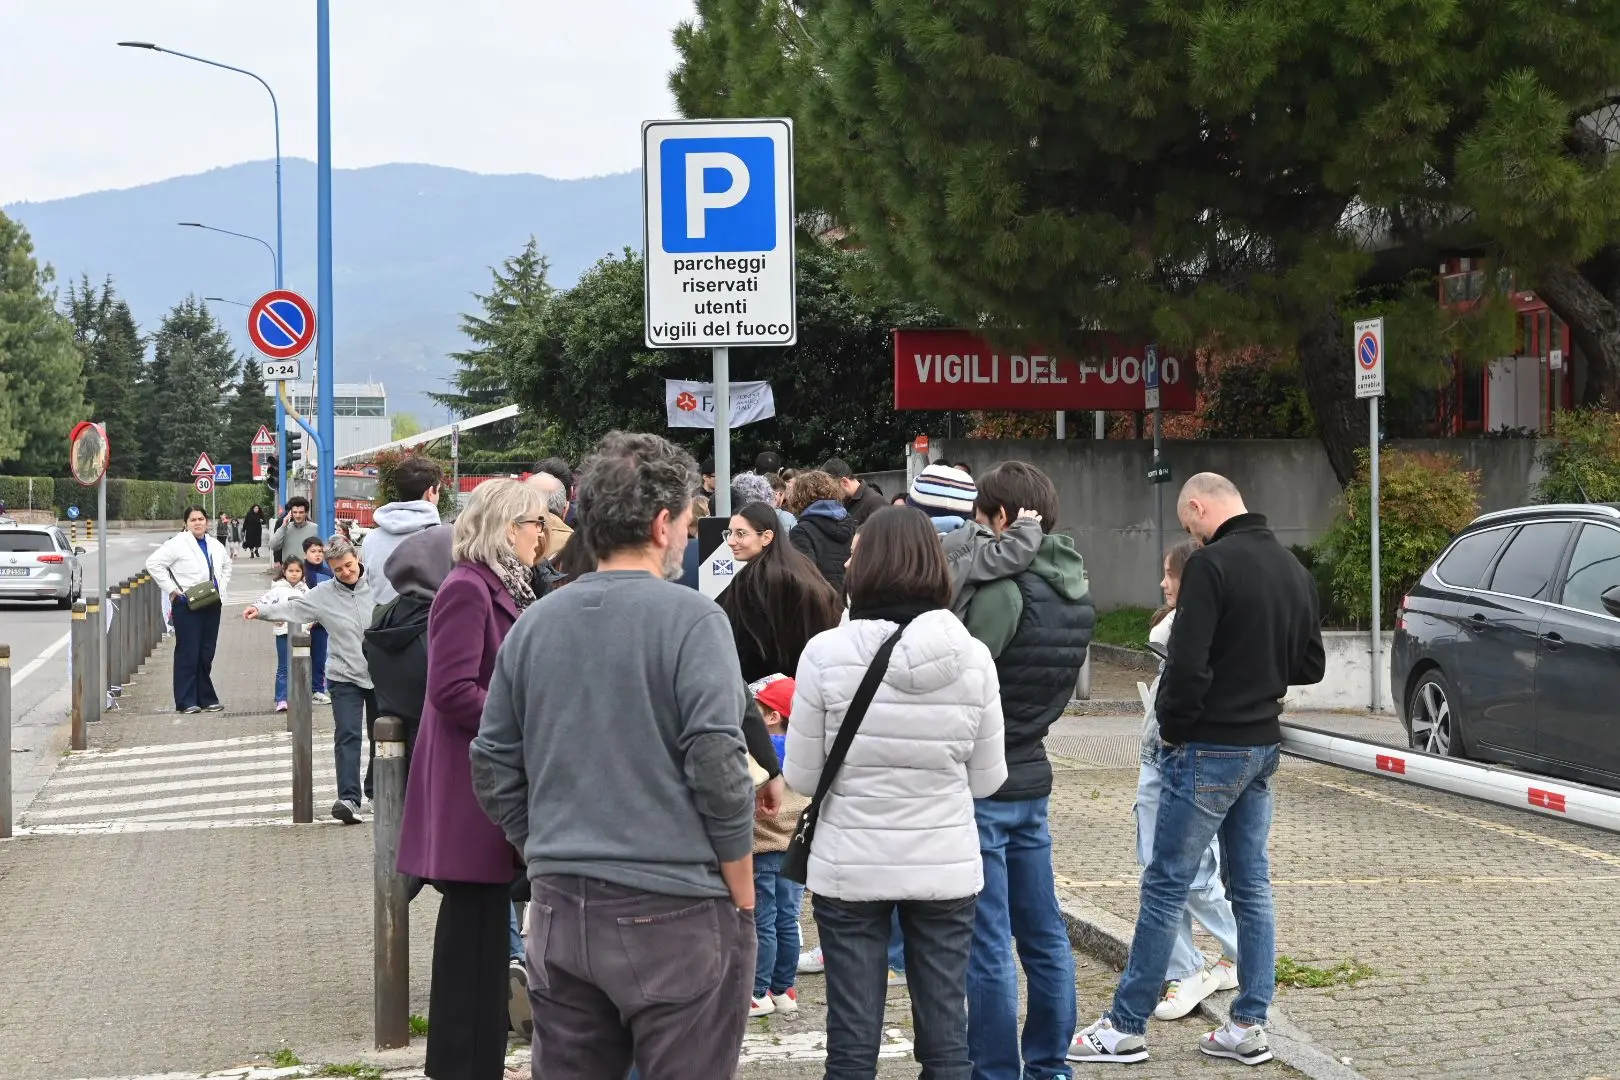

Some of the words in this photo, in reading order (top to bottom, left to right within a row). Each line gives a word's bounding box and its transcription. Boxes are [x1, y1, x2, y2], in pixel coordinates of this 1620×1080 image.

[685, 152, 750, 238] P
[674, 254, 766, 274] parcheggi
[682, 276, 758, 292] riservati
[694, 299, 747, 314] utenti
[653, 321, 696, 341] vigili
[702, 321, 730, 336] del
[736, 320, 790, 336] fuoco
[267, 365, 294, 375] 0-24
[913, 355, 999, 383] VIGILI
[1010, 355, 1068, 384] DEL
[1080, 356, 1180, 384] FUOO
[199, 480, 210, 489] 30
